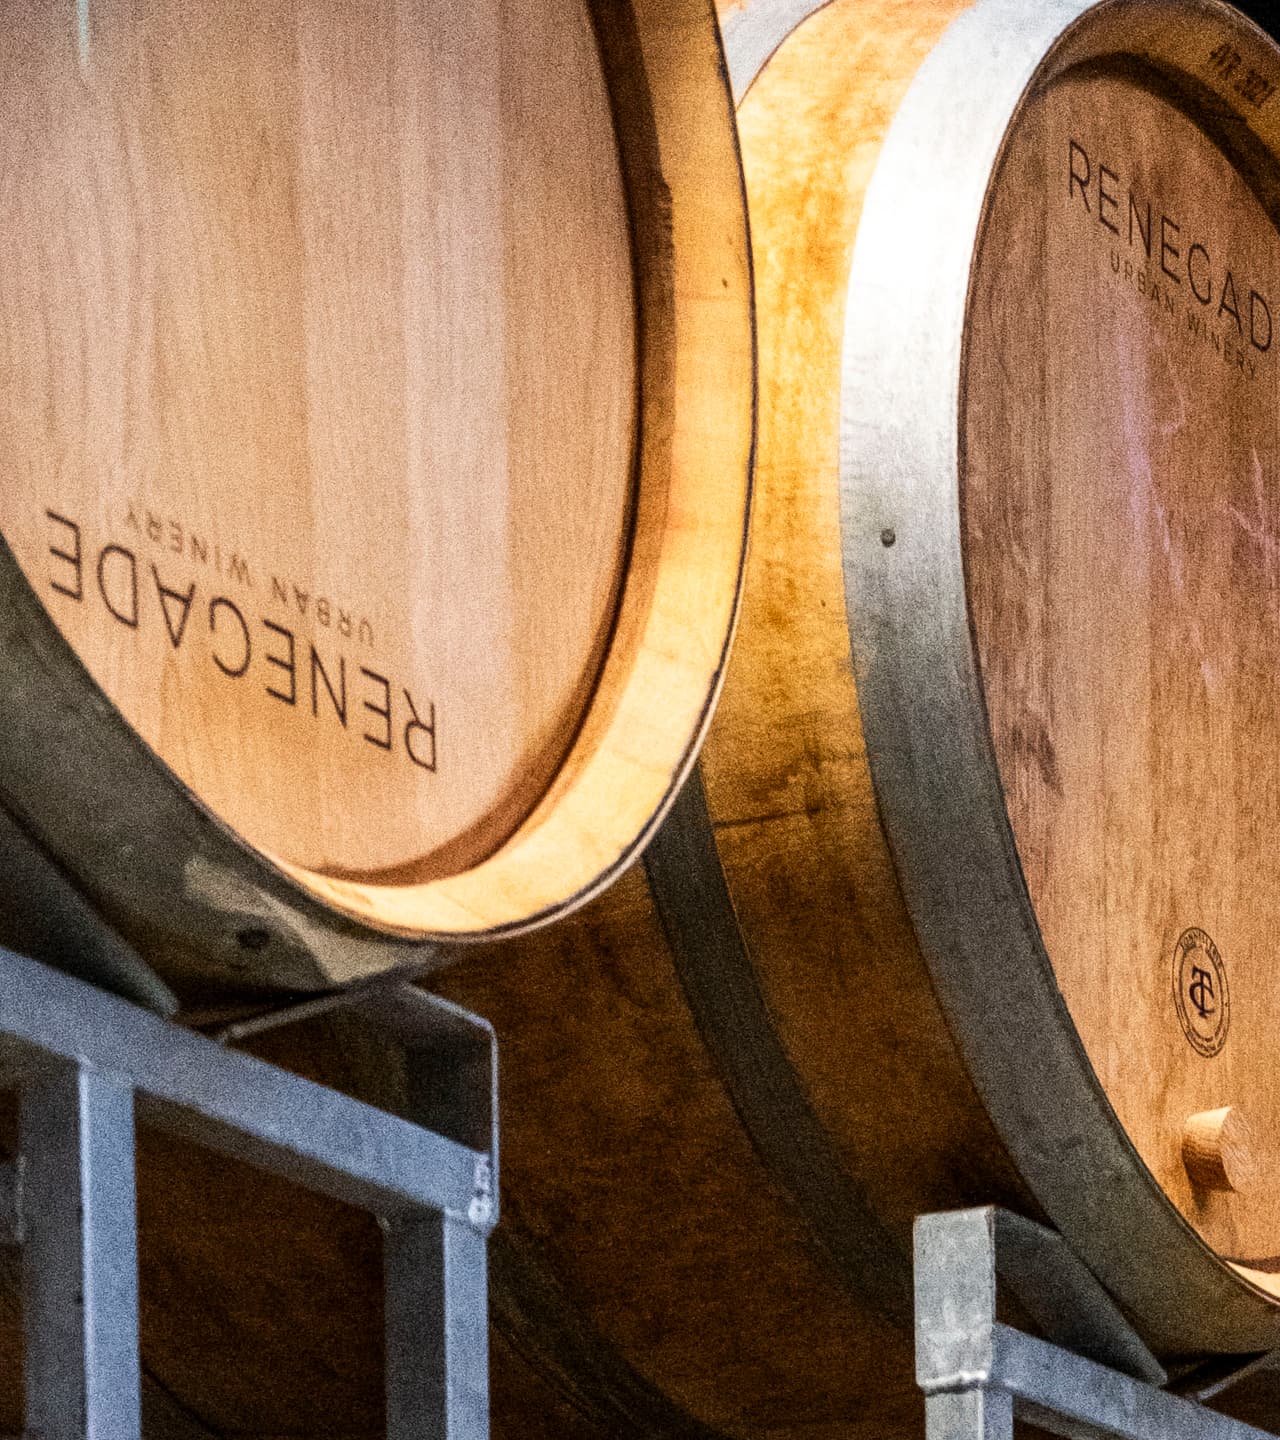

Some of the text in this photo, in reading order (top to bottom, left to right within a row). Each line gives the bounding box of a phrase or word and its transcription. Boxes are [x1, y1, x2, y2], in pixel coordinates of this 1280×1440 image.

[1110, 250, 1256, 382] URBAN WINERY
[45, 507, 438, 774] RENEGADE
[122, 503, 376, 649] URBAN WINERY
